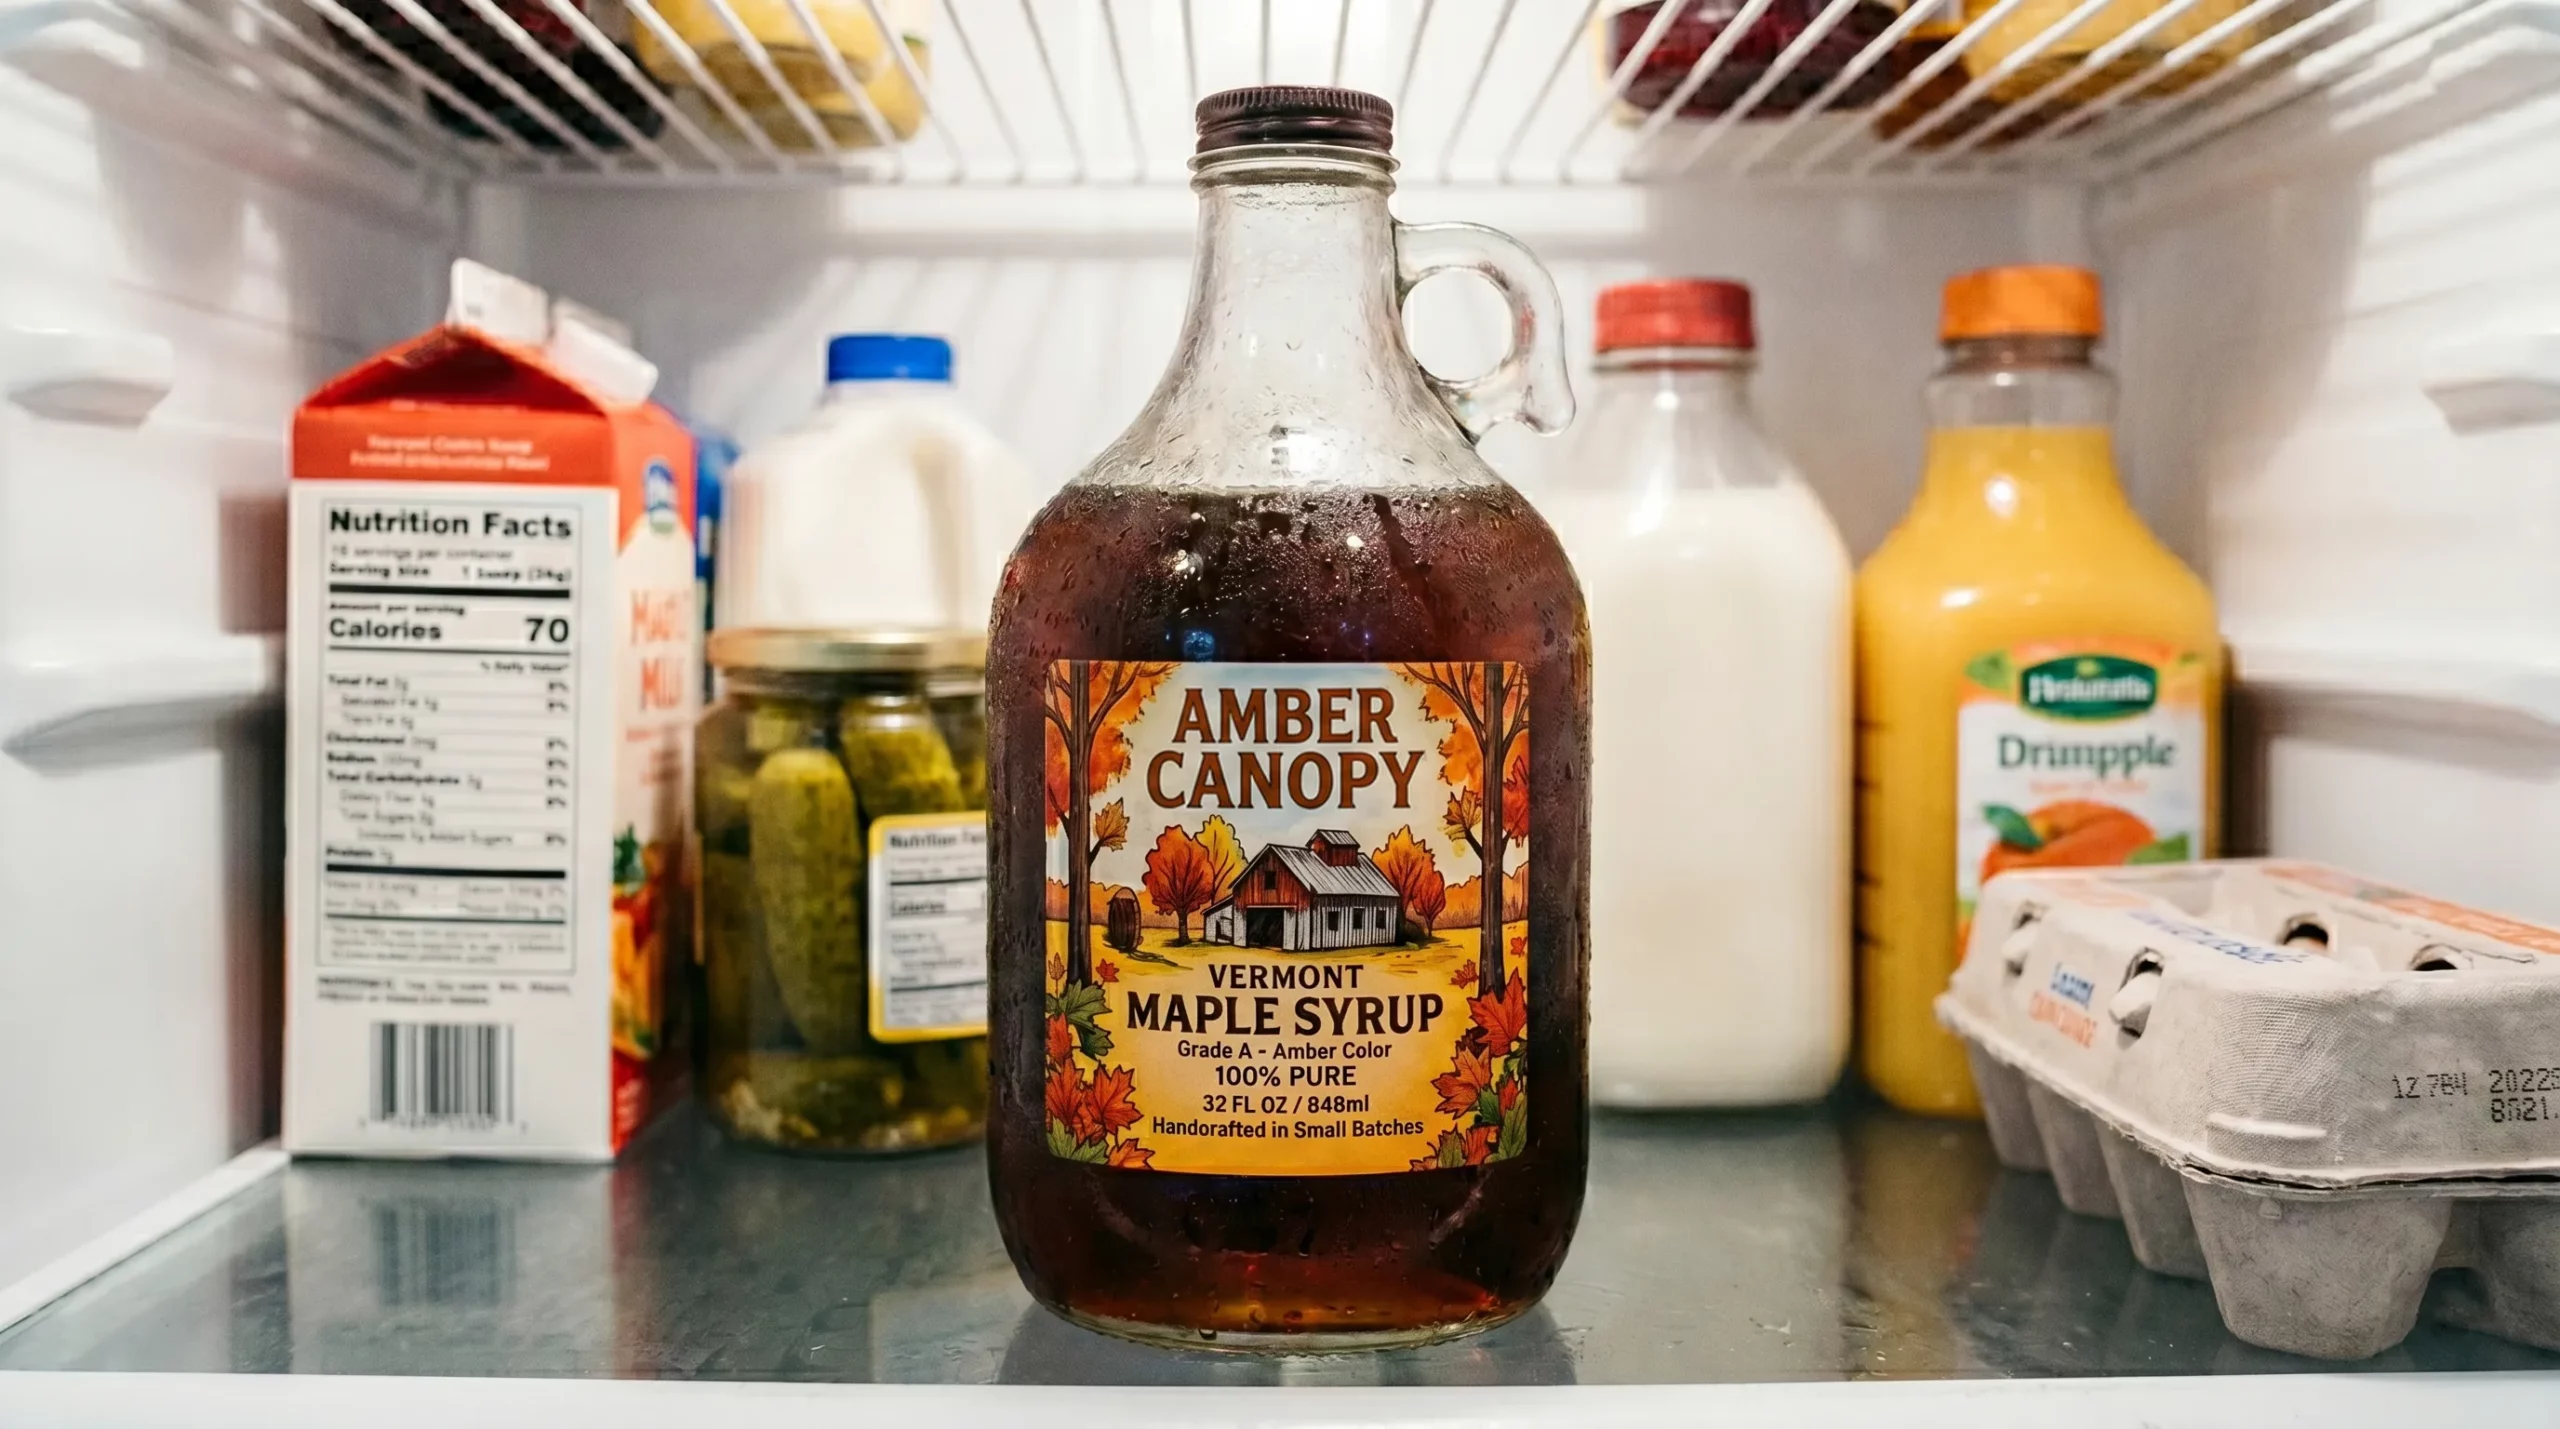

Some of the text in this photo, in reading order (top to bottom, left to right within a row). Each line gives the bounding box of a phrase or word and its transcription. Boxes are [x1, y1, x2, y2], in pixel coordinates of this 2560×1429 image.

[330, 509, 573, 537] Nutrition Facts
[329, 617, 570, 643] Calories 70
[1172, 687, 1399, 744] AMBER
[1146, 749, 1427, 810] CANOPY
[1207, 963, 1364, 989] VERMONT
[1126, 991, 1444, 1036] MAPLE SYRUP
[1177, 1040, 1233, 1060] Grade
[1237, 1042, 1253, 1060] A
[1272, 1041, 1337, 1060] Amber
[1342, 1041, 1392, 1060] Color
[1215, 1065, 1357, 1088] 100% PURE
[1202, 1094, 1370, 1114] 32 FL OZ / 848ml
[1271, 1120, 1289, 1138] in
[1294, 1120, 1346, 1139] Small
[1352, 1118, 1424, 1137] Batches
